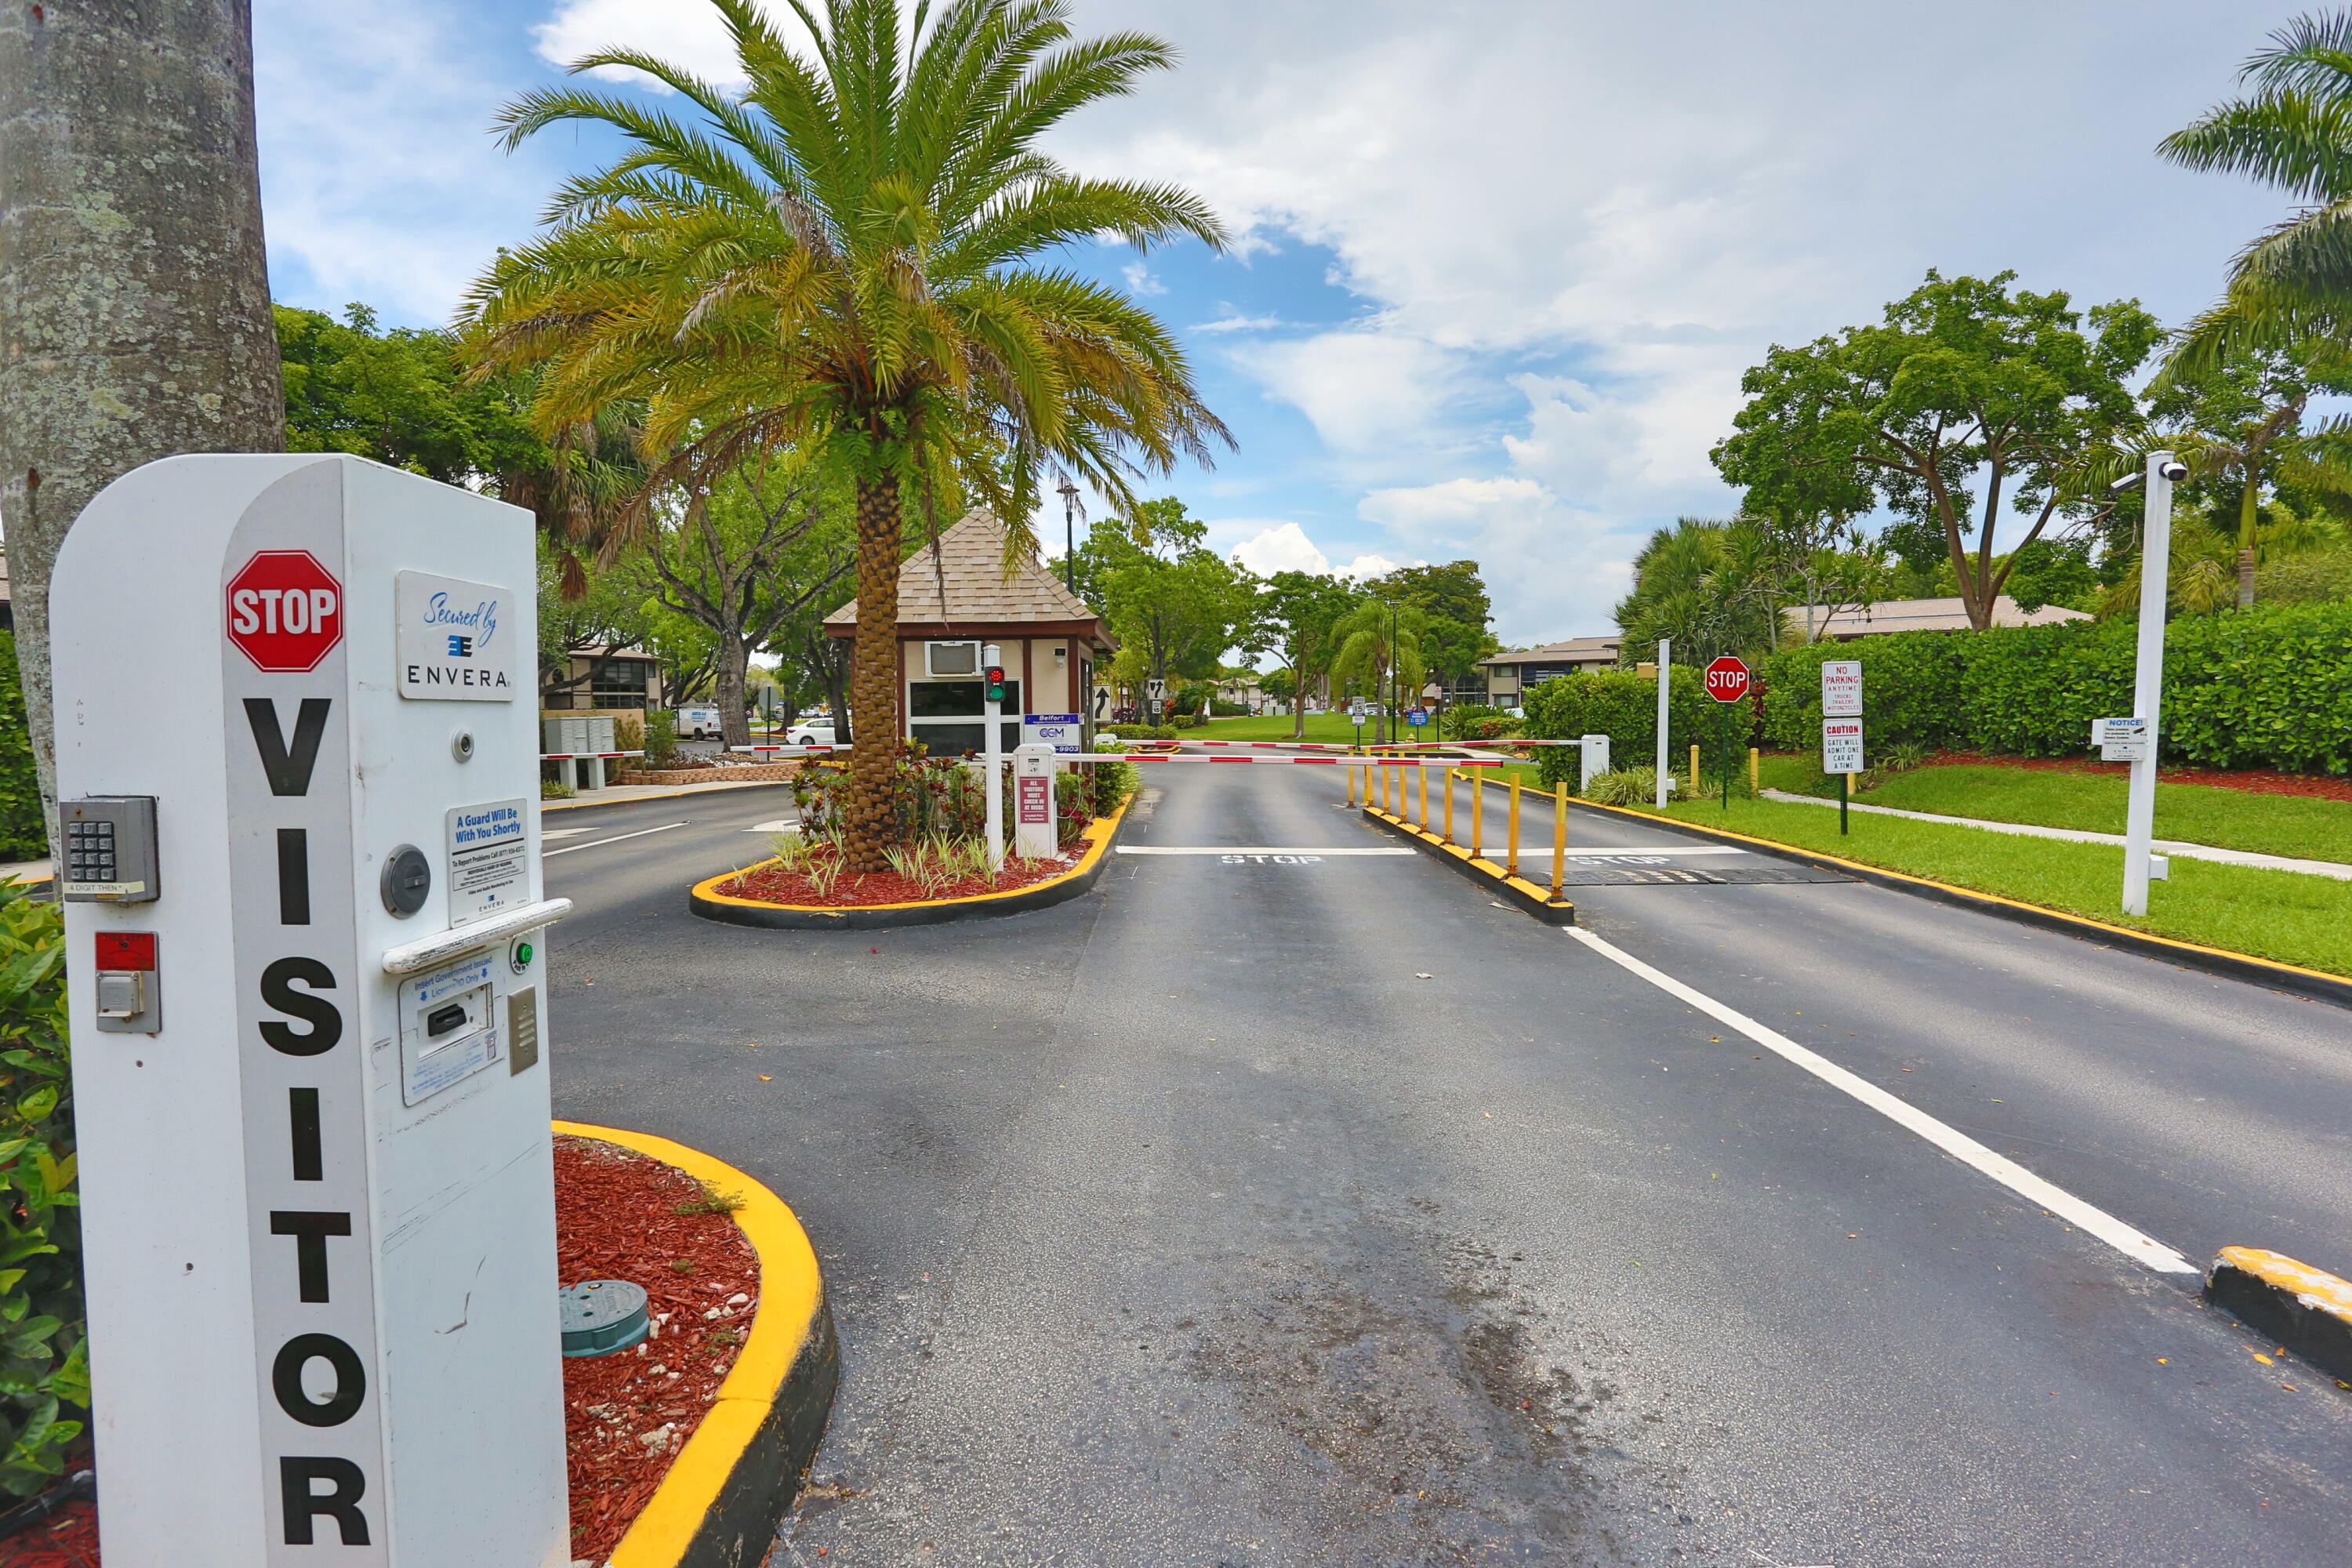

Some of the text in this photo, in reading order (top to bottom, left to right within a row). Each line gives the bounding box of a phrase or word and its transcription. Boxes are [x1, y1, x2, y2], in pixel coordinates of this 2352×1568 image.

[233, 589, 336, 634] STOP
[423, 592, 497, 648] Secured by
[408, 665, 507, 688] ENVERA
[1708, 670, 1746, 688] STOP
[1827, 725, 1859, 734] CAUTION
[457, 808, 517, 828] A Guard Will Be
[456, 821, 521, 843] With You Shortly
[458, 858, 472, 867] Report
[472, 854, 491, 863] Problems
[499, 848, 508, 858] (877)
[1221, 855, 1323, 865] STOP
[1568, 856, 1671, 865] STOP
[478, 900, 504, 912] ENVERA
[414, 956, 492, 991] Insert Government Issued
[466, 974, 479, 985] Only
[242, 698, 372, 1545] VISITOR
